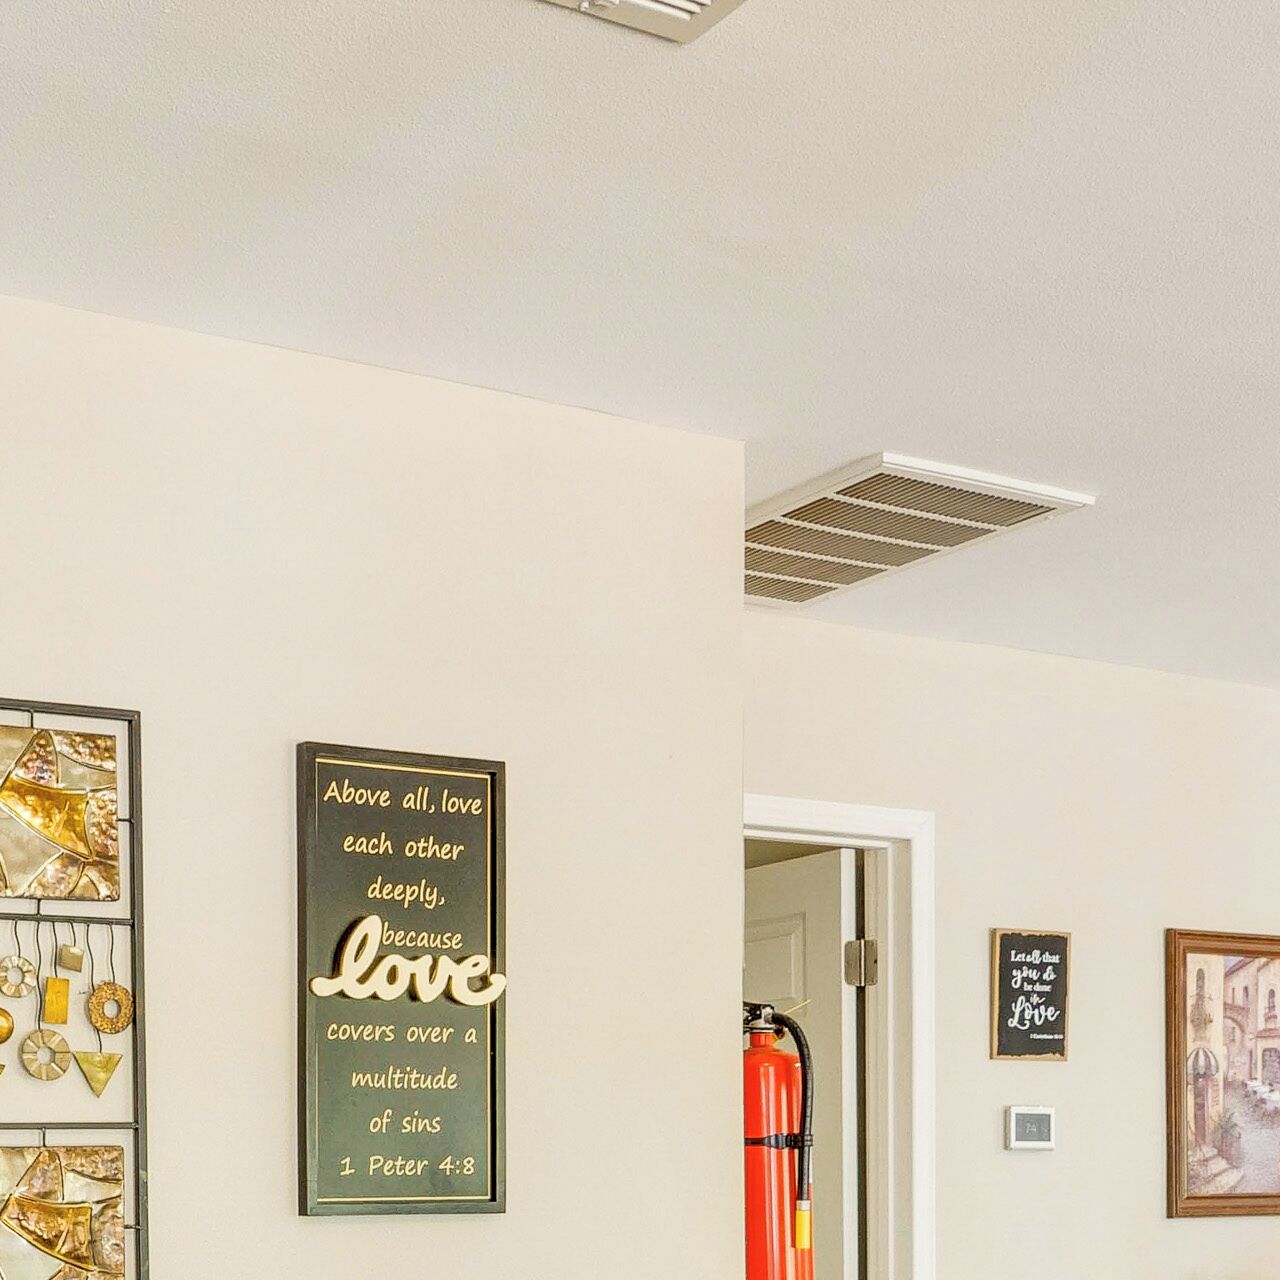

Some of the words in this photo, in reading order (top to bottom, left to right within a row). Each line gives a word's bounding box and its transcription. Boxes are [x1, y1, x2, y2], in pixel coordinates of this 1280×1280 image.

[323, 778, 391, 807] Above
[402, 786, 436, 813] all,
[441, 789, 483, 815] love
[343, 832, 393, 855] each
[404, 836, 465, 860] other
[367, 875, 445, 909] deeply,
[381, 921, 463, 949] because
[308, 914, 508, 1007] love
[1010, 949, 1025, 962] Let
[1042, 951, 1060, 963] that
[1011, 965, 1040, 989] you
[1023, 981, 1033, 992] be
[1033, 983, 1052, 992] done
[1007, 995, 1060, 1030] Love
[326, 1023, 395, 1042] covers
[406, 1026, 454, 1043] over
[464, 1028, 478, 1044] a
[351, 1065, 458, 1089] multitude
[369, 1109, 393, 1133] of
[401, 1110, 441, 1133] sins
[339, 1156, 356, 1176] 1
[369, 1155, 428, 1176] Peter
[438, 1156, 475, 1176] 4:8
